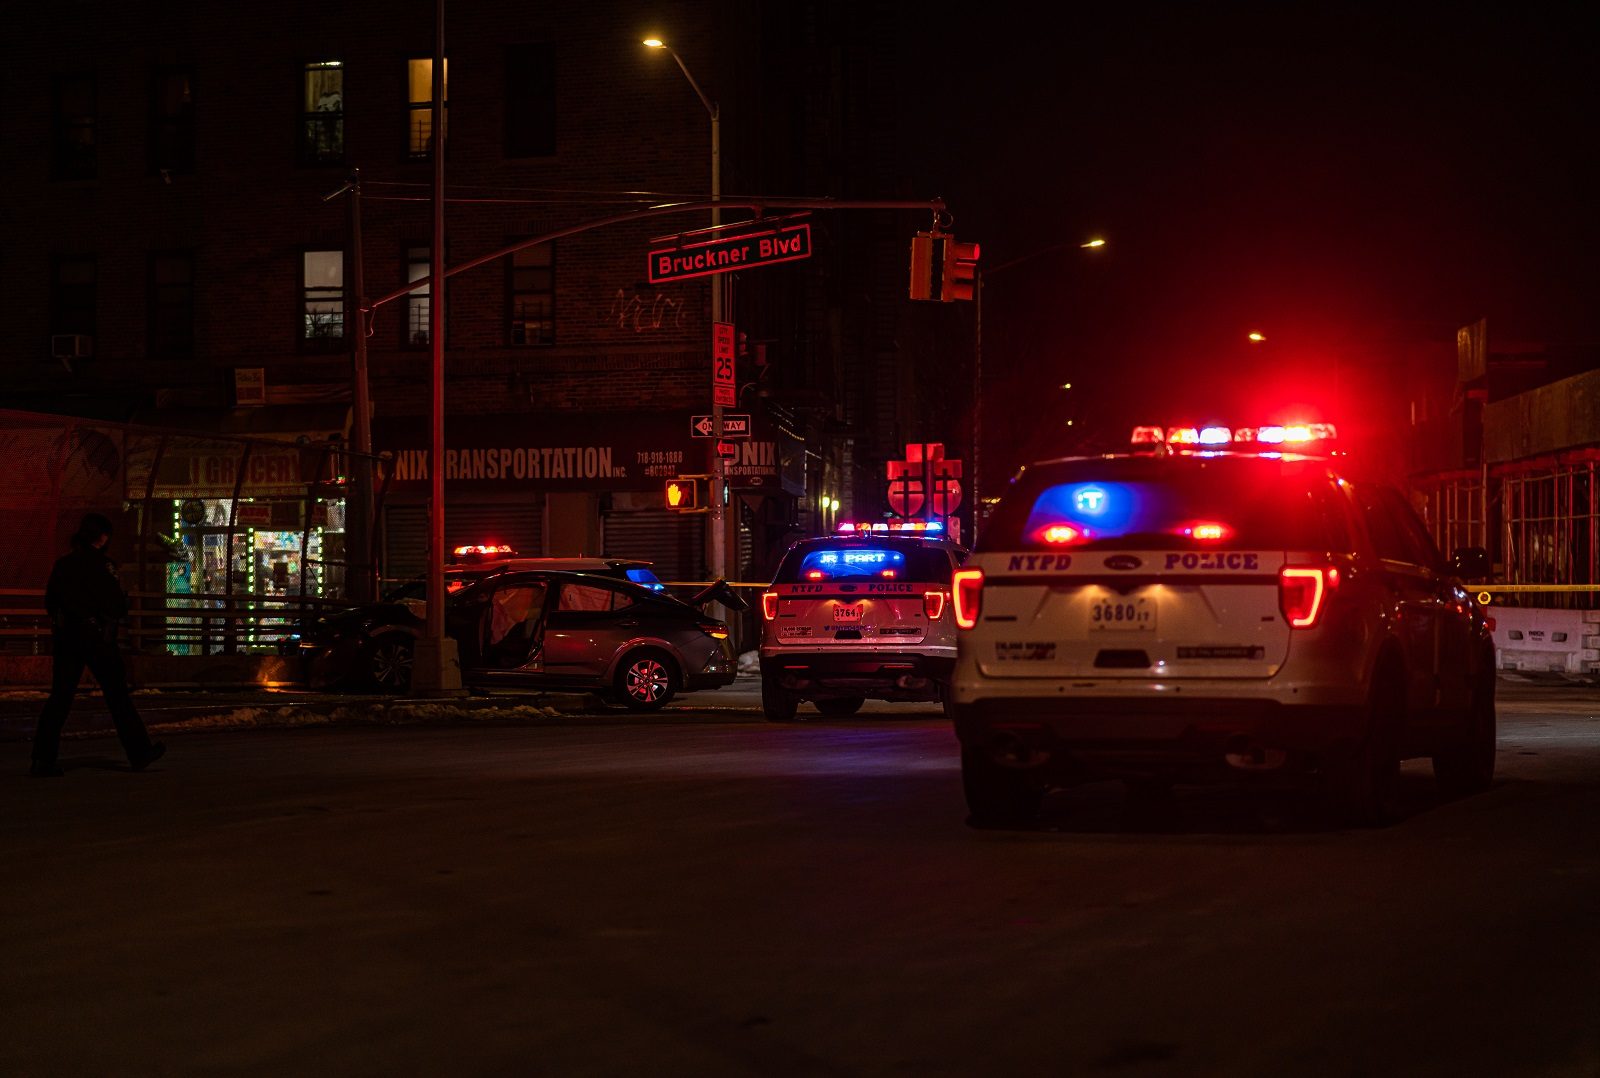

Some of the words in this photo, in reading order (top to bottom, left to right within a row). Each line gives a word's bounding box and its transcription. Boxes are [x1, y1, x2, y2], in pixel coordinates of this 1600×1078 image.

[658, 246, 750, 275] Bruckner
[759, 233, 801, 258] Blvd
[717, 357, 733, 380] 25
[723, 421, 742, 431] WAY
[446, 447, 613, 480] RANSPORTATION
[844, 552, 886, 563] PART
[1008, 555, 1071, 571] NYPD
[1165, 553, 1259, 570] POLICE
[791, 584, 823, 593] NYPD
[868, 583, 913, 593] POLICE
[834, 608, 856, 617] 3764
[1092, 604, 1135, 622] 3680
